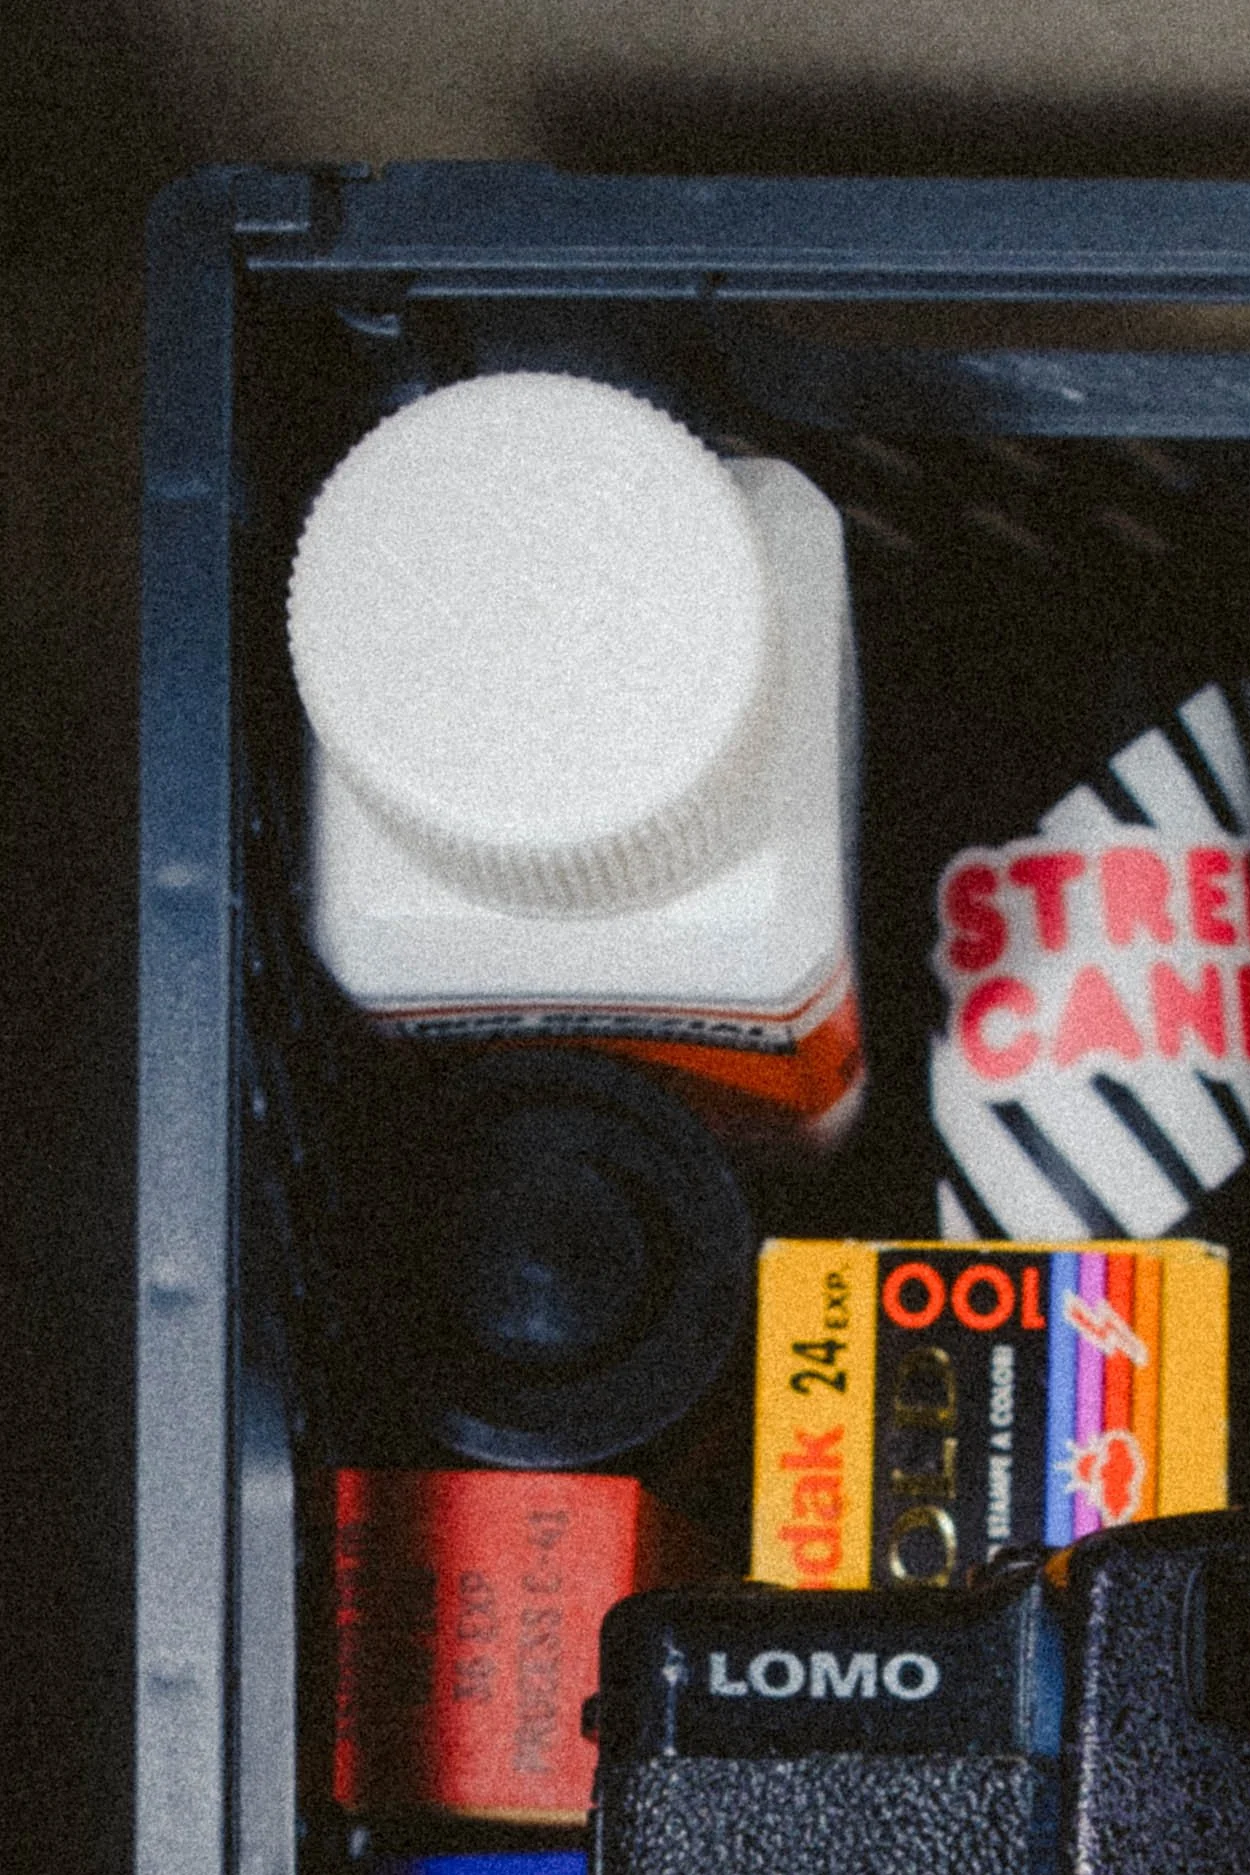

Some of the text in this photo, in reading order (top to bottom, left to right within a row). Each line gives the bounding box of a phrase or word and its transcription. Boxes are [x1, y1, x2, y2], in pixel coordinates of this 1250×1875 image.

[881, 1262, 1047, 1333] 100
[789, 1337, 847, 1397] 24
[889, 1345, 958, 1587] OLD
[778, 1425, 846, 1589] dak
[709, 1650, 941, 1700] LOMO
